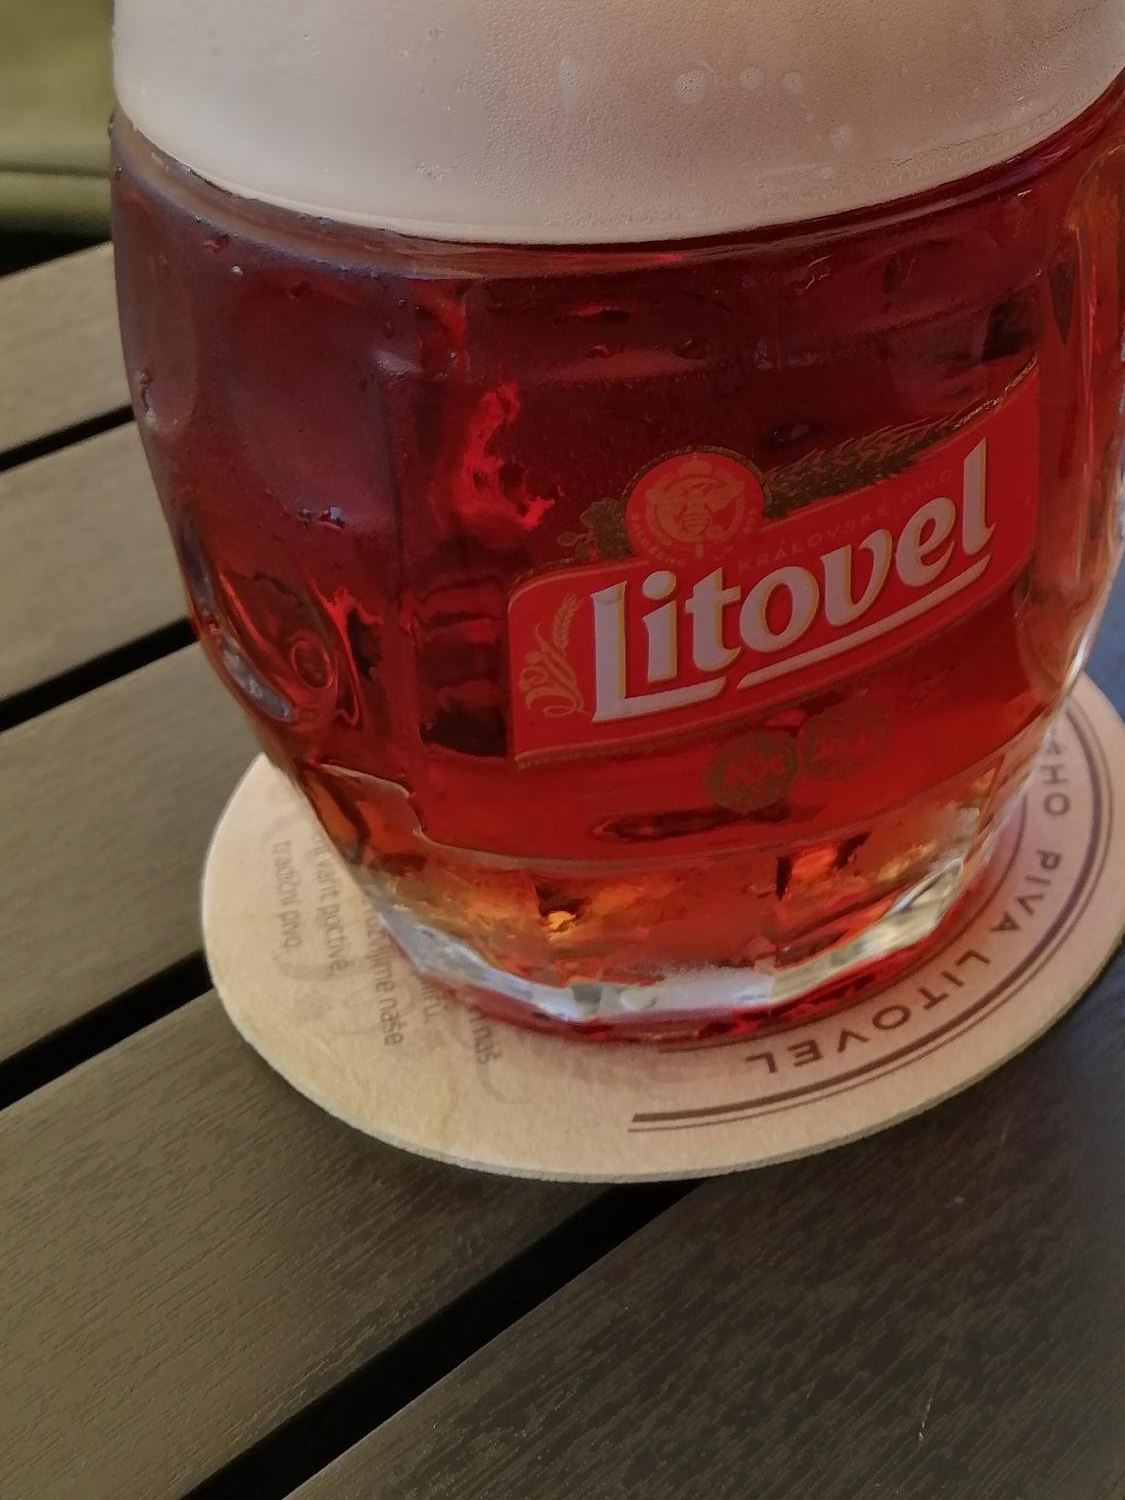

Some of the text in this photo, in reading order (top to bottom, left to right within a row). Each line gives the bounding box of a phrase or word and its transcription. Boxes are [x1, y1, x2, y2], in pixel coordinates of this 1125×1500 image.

[590, 438, 996, 723] Litovel
[989, 848, 1061, 934] PIVA
[746, 948, 991, 1075] LITOVEL
